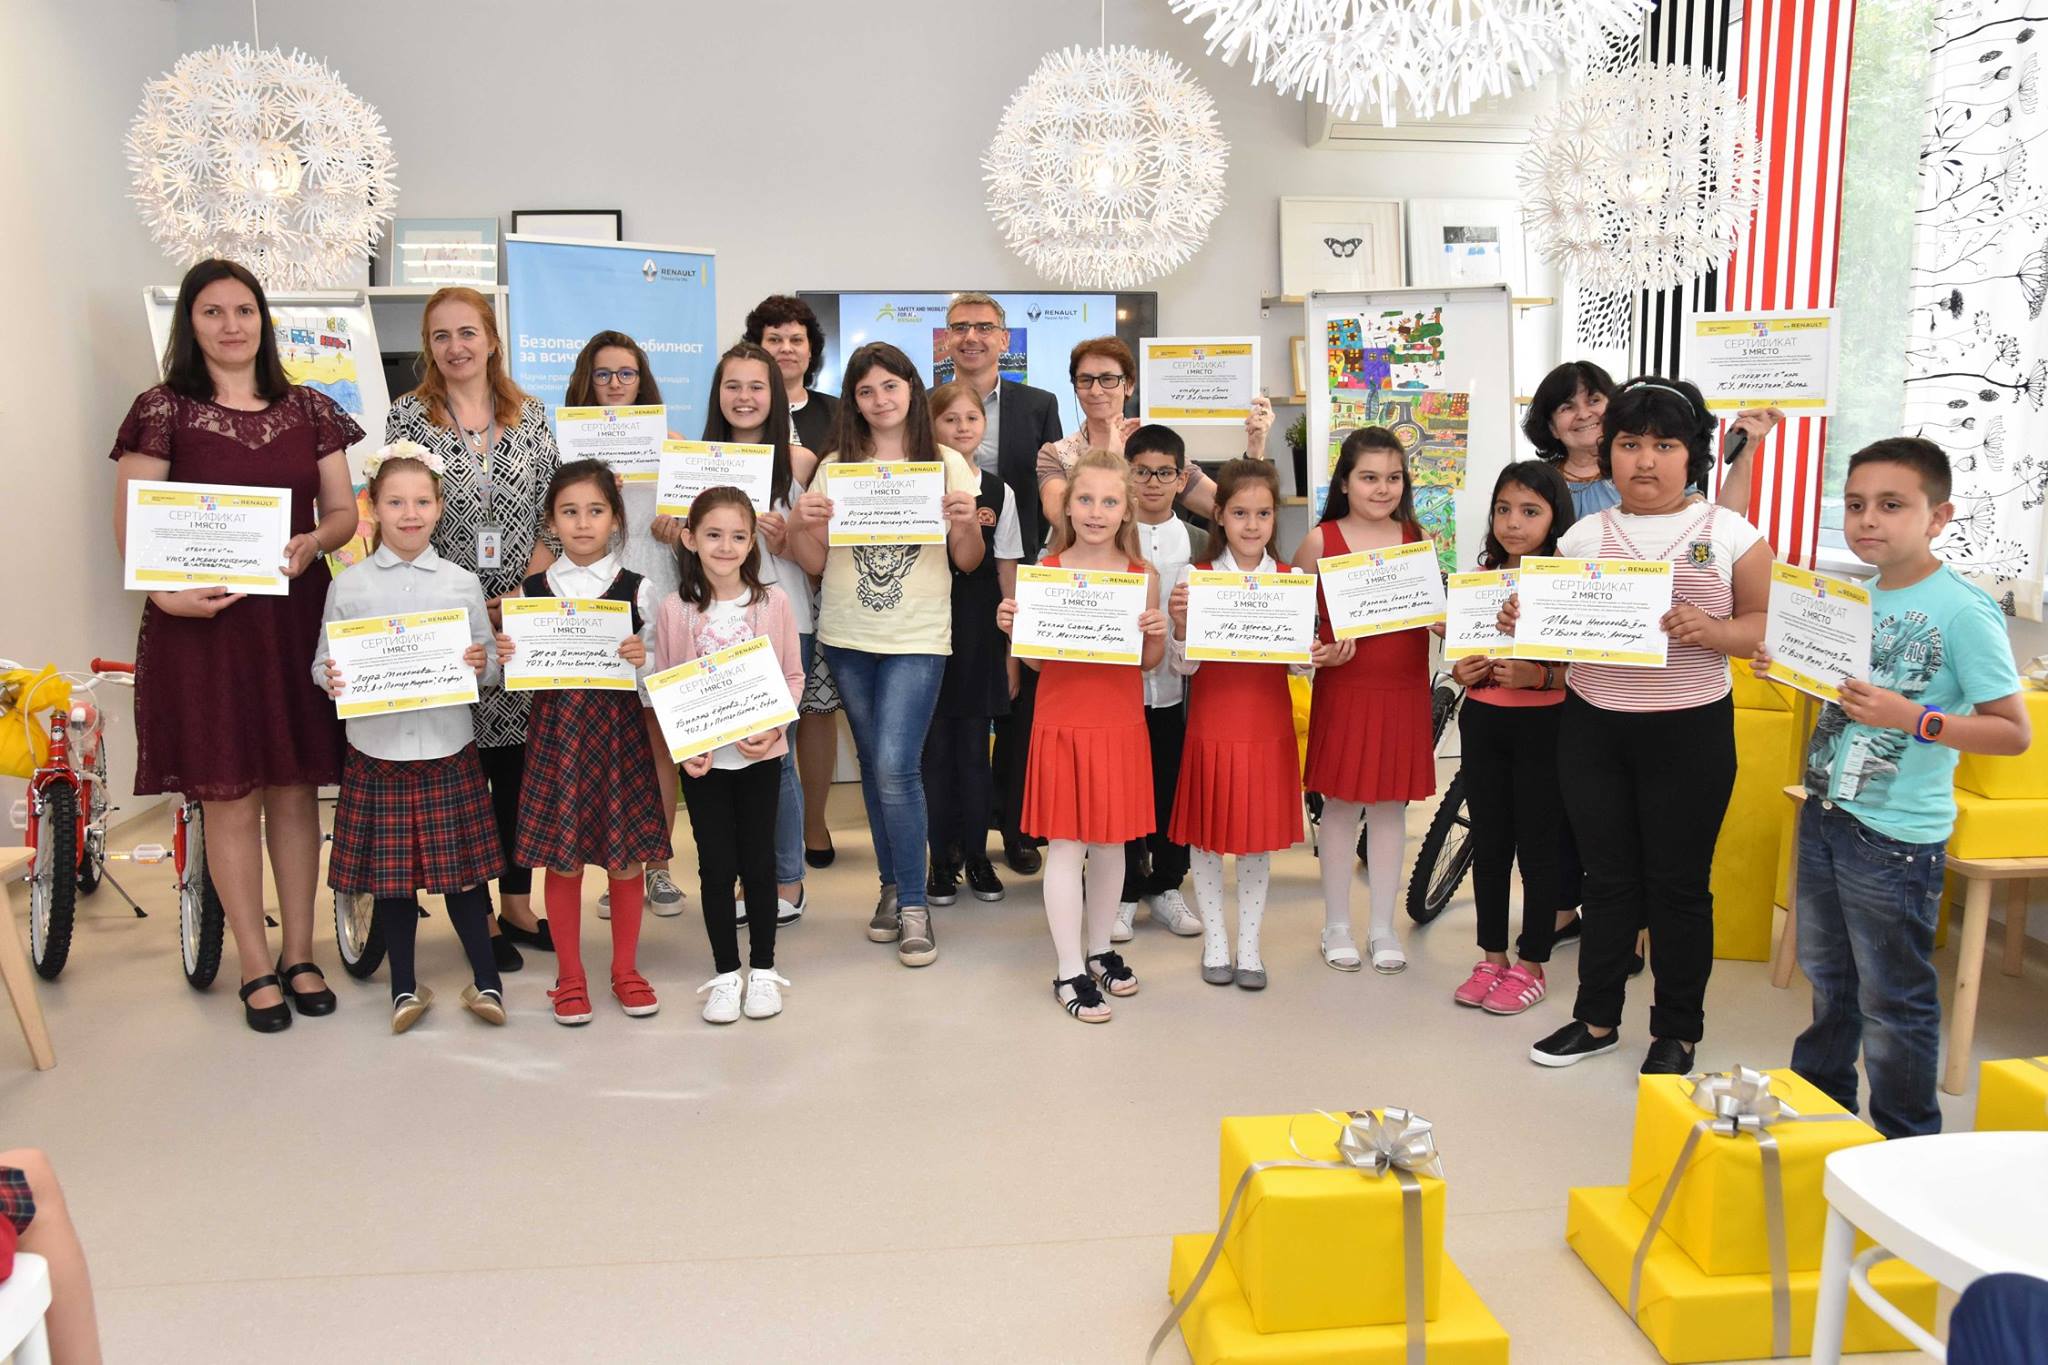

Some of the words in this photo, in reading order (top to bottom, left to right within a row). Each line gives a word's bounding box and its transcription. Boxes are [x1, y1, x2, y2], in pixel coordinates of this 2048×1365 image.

[661, 268, 696, 276] RENAULT
[638, 339, 704, 353] обилност
[1724, 337, 1798, 348] СЕРТИФИКАТ
[1748, 347, 1779, 355] МЯСТО
[519, 352, 536, 362] за
[540, 353, 578, 364] всич
[1172, 360, 1226, 369] СЕРТИФИКАТ
[581, 422, 640, 432] СЕРТИФИКАТ
[853, 479, 914, 489] СЕРТИФИКАТ
[168, 508, 247, 524] СЕРТИФИКАТ
[194, 521, 227, 530] МЯСТО
[1346, 562, 1410, 581] СЕРТИФИКАТ
[1370, 573, 1397, 584] МЯСТО
[1551, 579, 1633, 592] СЕРТИФИКАТ
[1044, 586, 1114, 601] СЕРТИФИКАТ
[1216, 589, 1285, 601] СЕРТИФИКАТ
[1579, 591, 1613, 600] МЯСТО
[1067, 598, 1097, 607] МЯСТО
[1239, 600, 1268, 608] МЯСТО
[426, 613, 460, 623] RENAULT
[533, 616, 602, 627] СЕРТИФИКАТ
[1806, 608, 1831, 627] МЯСТО
[557, 626, 586, 634] МЯСТО
[360, 630, 436, 650] СЕРТИФИКАТ
[386, 643, 419, 654] МЯСТО
[733, 642, 764, 657] RENAULT
[677, 663, 747, 694] СЕРТИФИКАТ
[703, 678, 733, 693] МЯСТО
